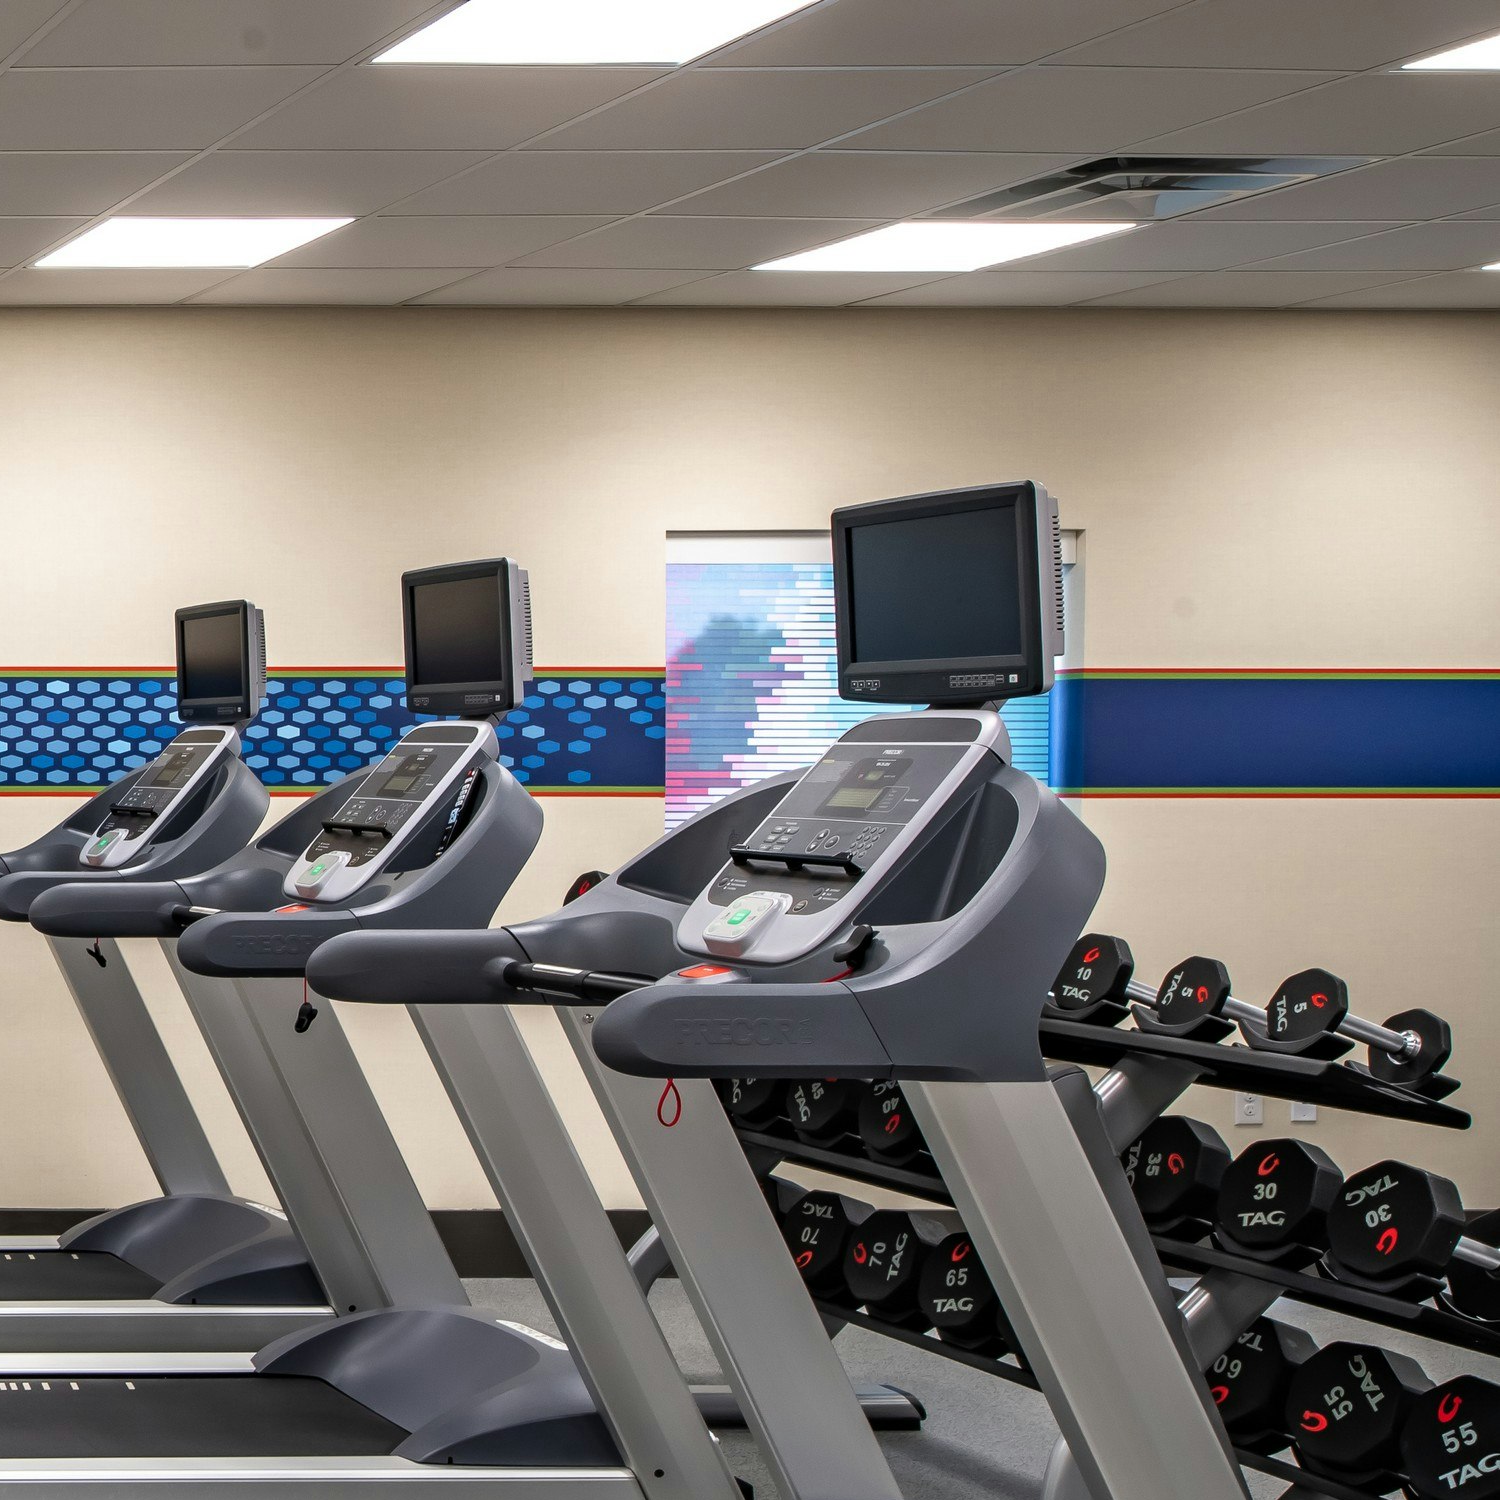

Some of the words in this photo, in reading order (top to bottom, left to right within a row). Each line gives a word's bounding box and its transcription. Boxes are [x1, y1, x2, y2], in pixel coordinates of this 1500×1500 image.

[1076, 966, 1092, 981] 10
[1062, 985, 1091, 1002] TAG
[1161, 971, 1183, 1006] TAG
[1181, 986, 1193, 998] 5
[1276, 995, 1288, 1032] TAG
[1293, 1001, 1307, 1014] 5
[673, 1018, 799, 1046] PRECOR
[731, 1078, 742, 1104] AG
[811, 1082, 825, 1100] 45
[793, 1085, 811, 1122] TAG
[882, 1096, 900, 1114] 40
[1145, 1153, 1163, 1177] 35
[1253, 1182, 1277, 1201] 30
[1345, 1174, 1399, 1207] TAG
[802, 1202, 834, 1219] TAG
[1237, 1210, 1286, 1227] TAG
[1365, 1203, 1392, 1228] 30
[801, 1226, 820, 1245] 70
[868, 1242, 886, 1268] 70
[886, 1232, 908, 1281] TAG
[946, 1268, 968, 1286] 65
[933, 1297, 974, 1313] TAG
[1238, 1331, 1263, 1352] TA
[1213, 1354, 1242, 1379] 60
[1348, 1354, 1385, 1412] TAG
[1323, 1385, 1353, 1421] 55
[1442, 1421, 1478, 1453] 55
[1438, 1453, 1500, 1490] TAG
